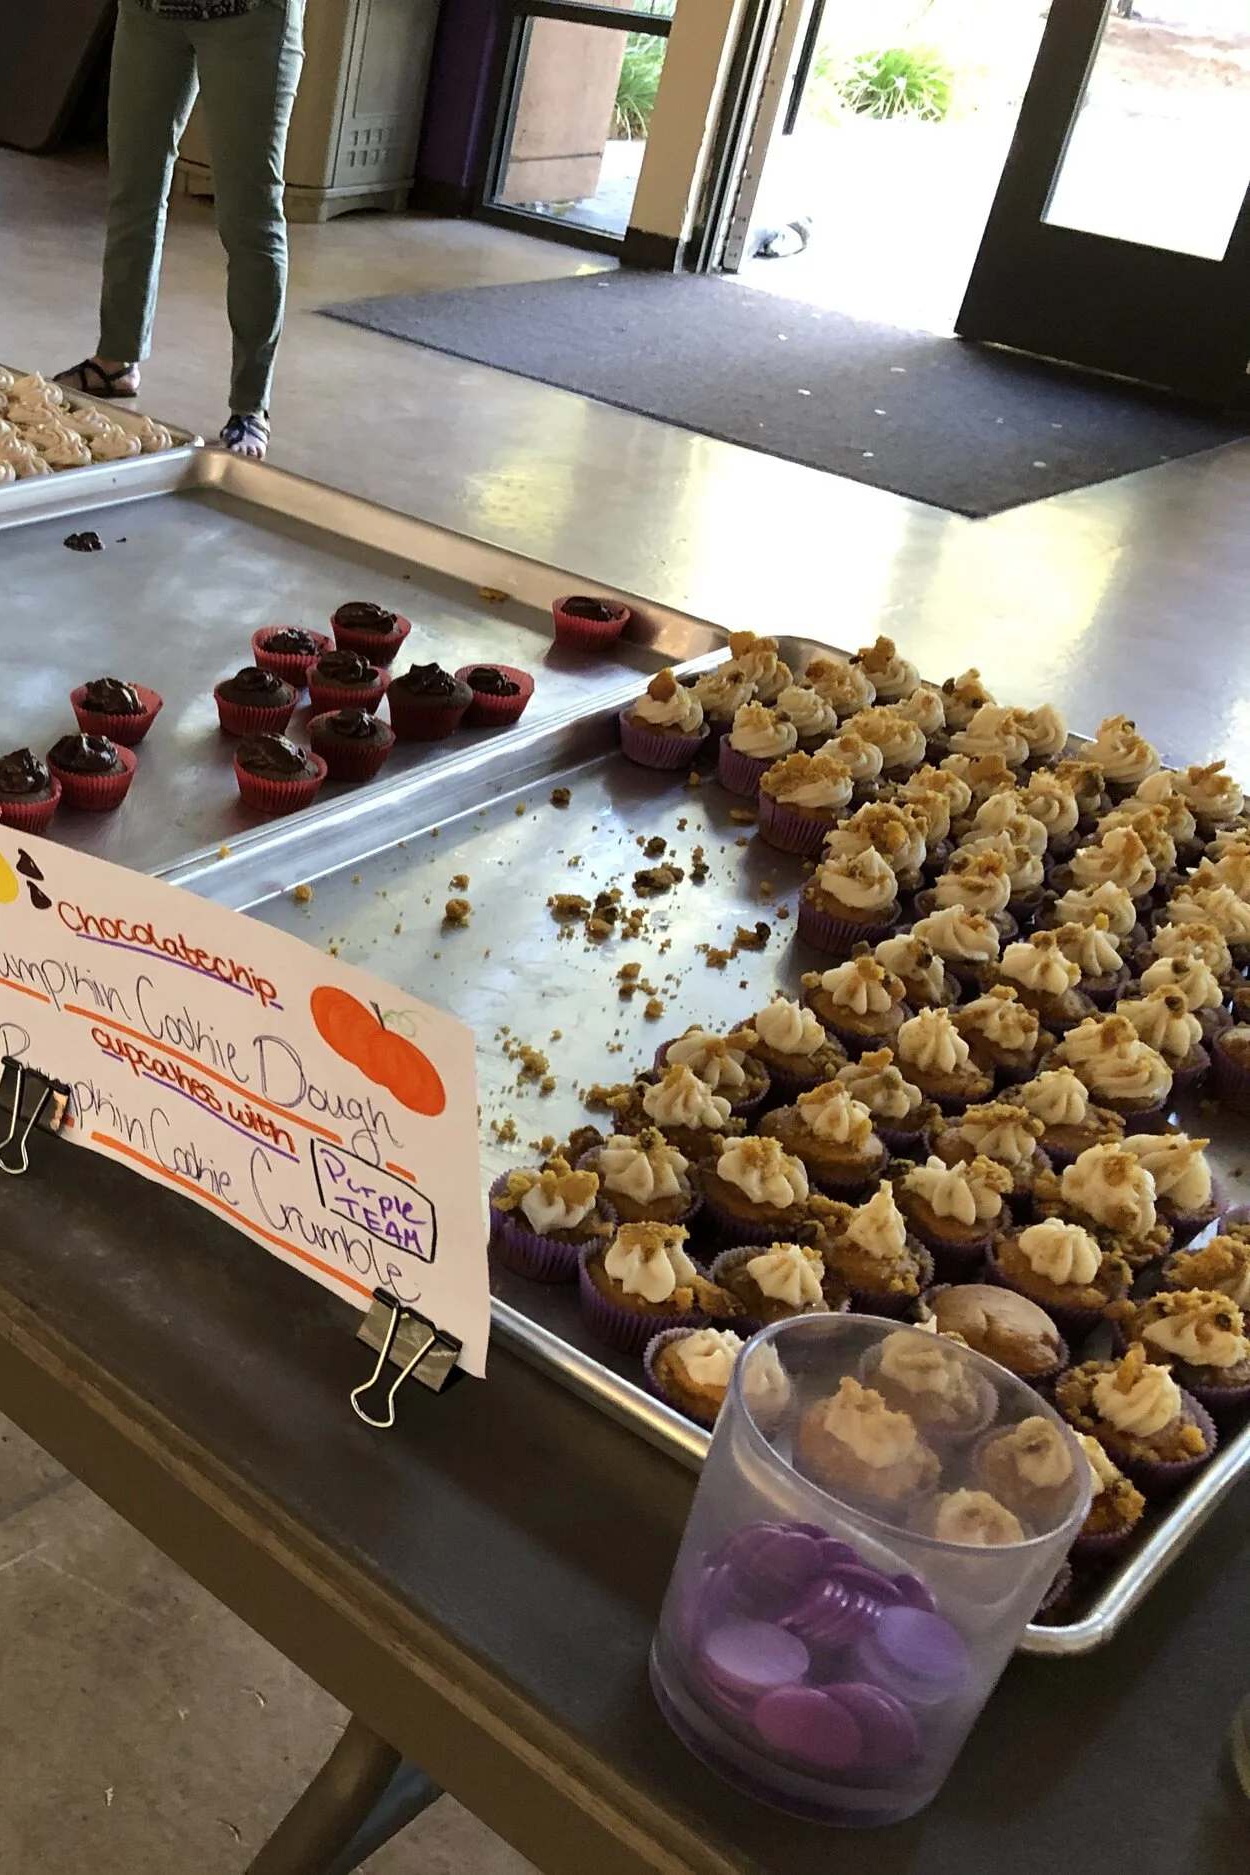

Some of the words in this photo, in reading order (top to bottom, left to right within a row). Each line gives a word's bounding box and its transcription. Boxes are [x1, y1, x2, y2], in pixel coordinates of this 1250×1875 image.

[91, 1027, 223, 1112] cupcakes
[228, 1101, 298, 1154] with
[136, 975, 249, 1083] Cookie
[253, 1035, 404, 1167] Dough
[150, 1108, 238, 1207] Cookie
[250, 1146, 421, 1302] Crumble
[320, 1148, 427, 1225] Purple
[334, 1197, 423, 1254] TEAM
